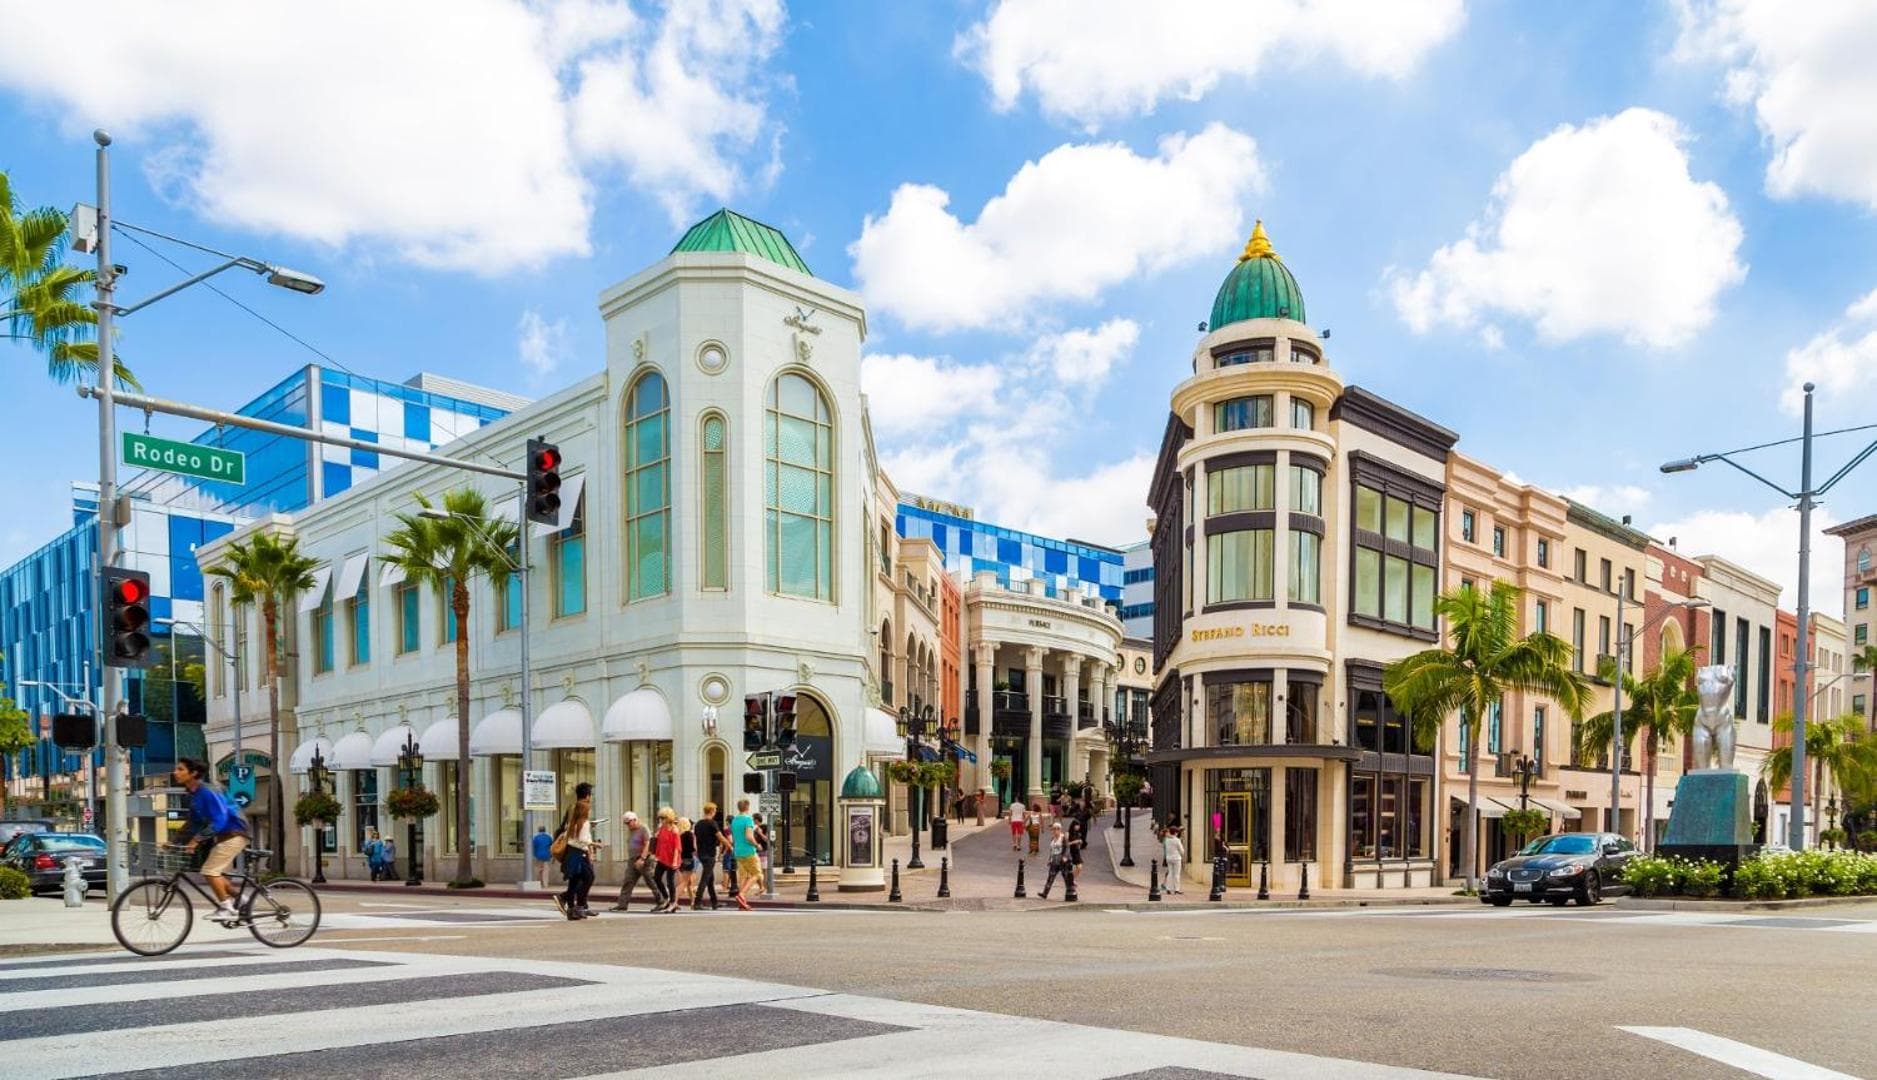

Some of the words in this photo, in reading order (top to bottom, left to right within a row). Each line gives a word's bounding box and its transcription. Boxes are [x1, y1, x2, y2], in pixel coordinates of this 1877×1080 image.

[134, 442, 201, 469] Rodeo
[211, 456, 234, 475] Dr
[238, 767, 249, 779] P
